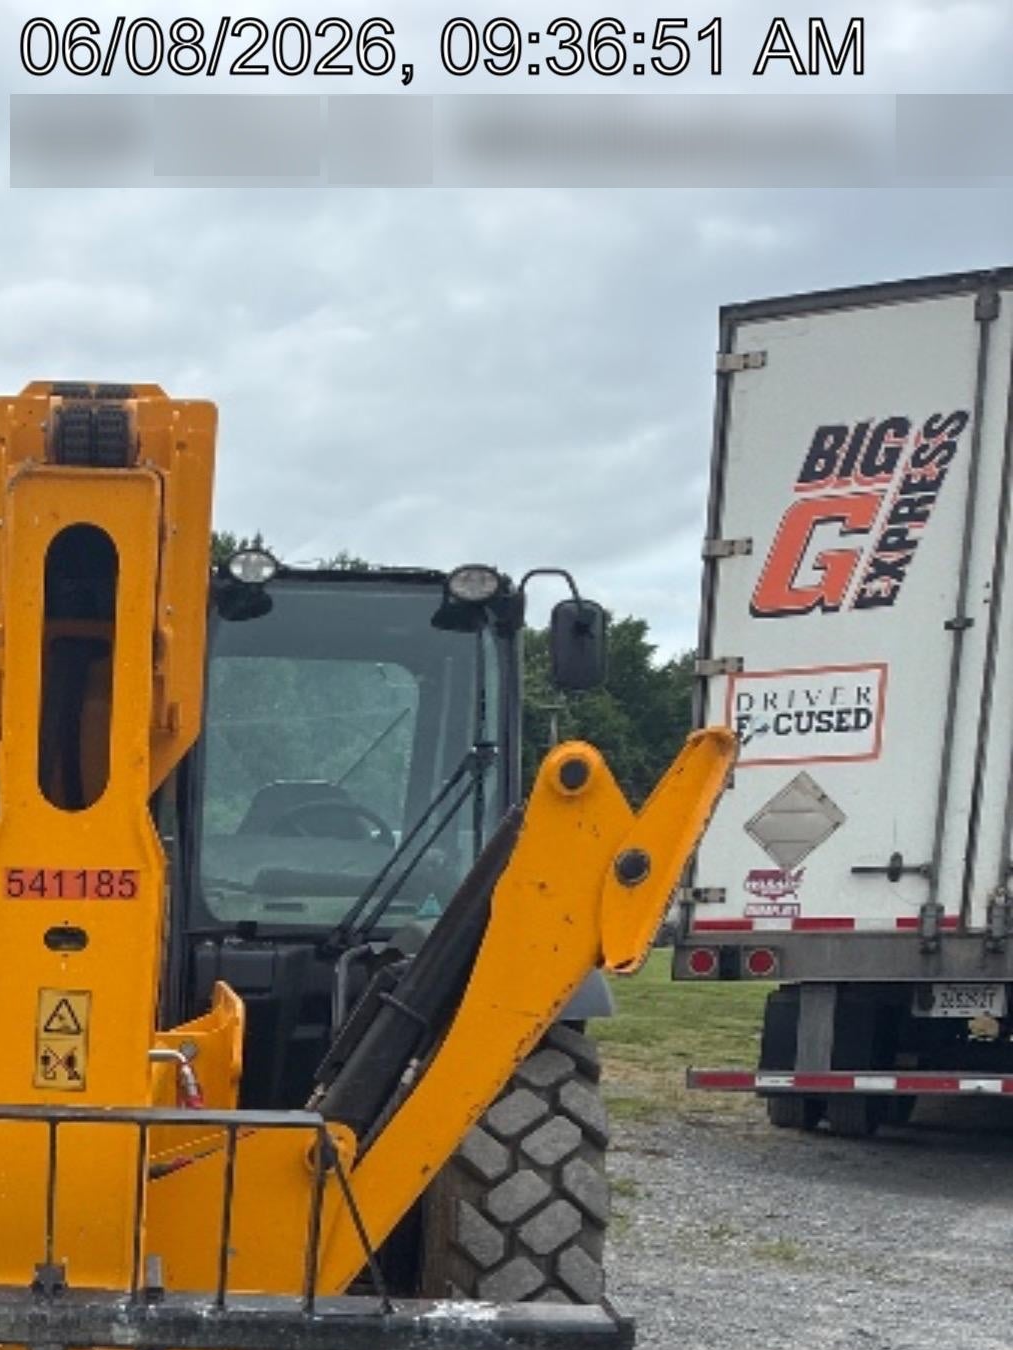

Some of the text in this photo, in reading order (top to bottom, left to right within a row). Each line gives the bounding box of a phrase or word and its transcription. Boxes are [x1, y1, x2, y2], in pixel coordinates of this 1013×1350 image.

[794, 416, 911, 491] BIG
[852, 410, 969, 609] EXPRESS
[749, 492, 886, 617] G
[735, 686, 872, 711] DRIVER
[5, 869, 139, 899] 541185
